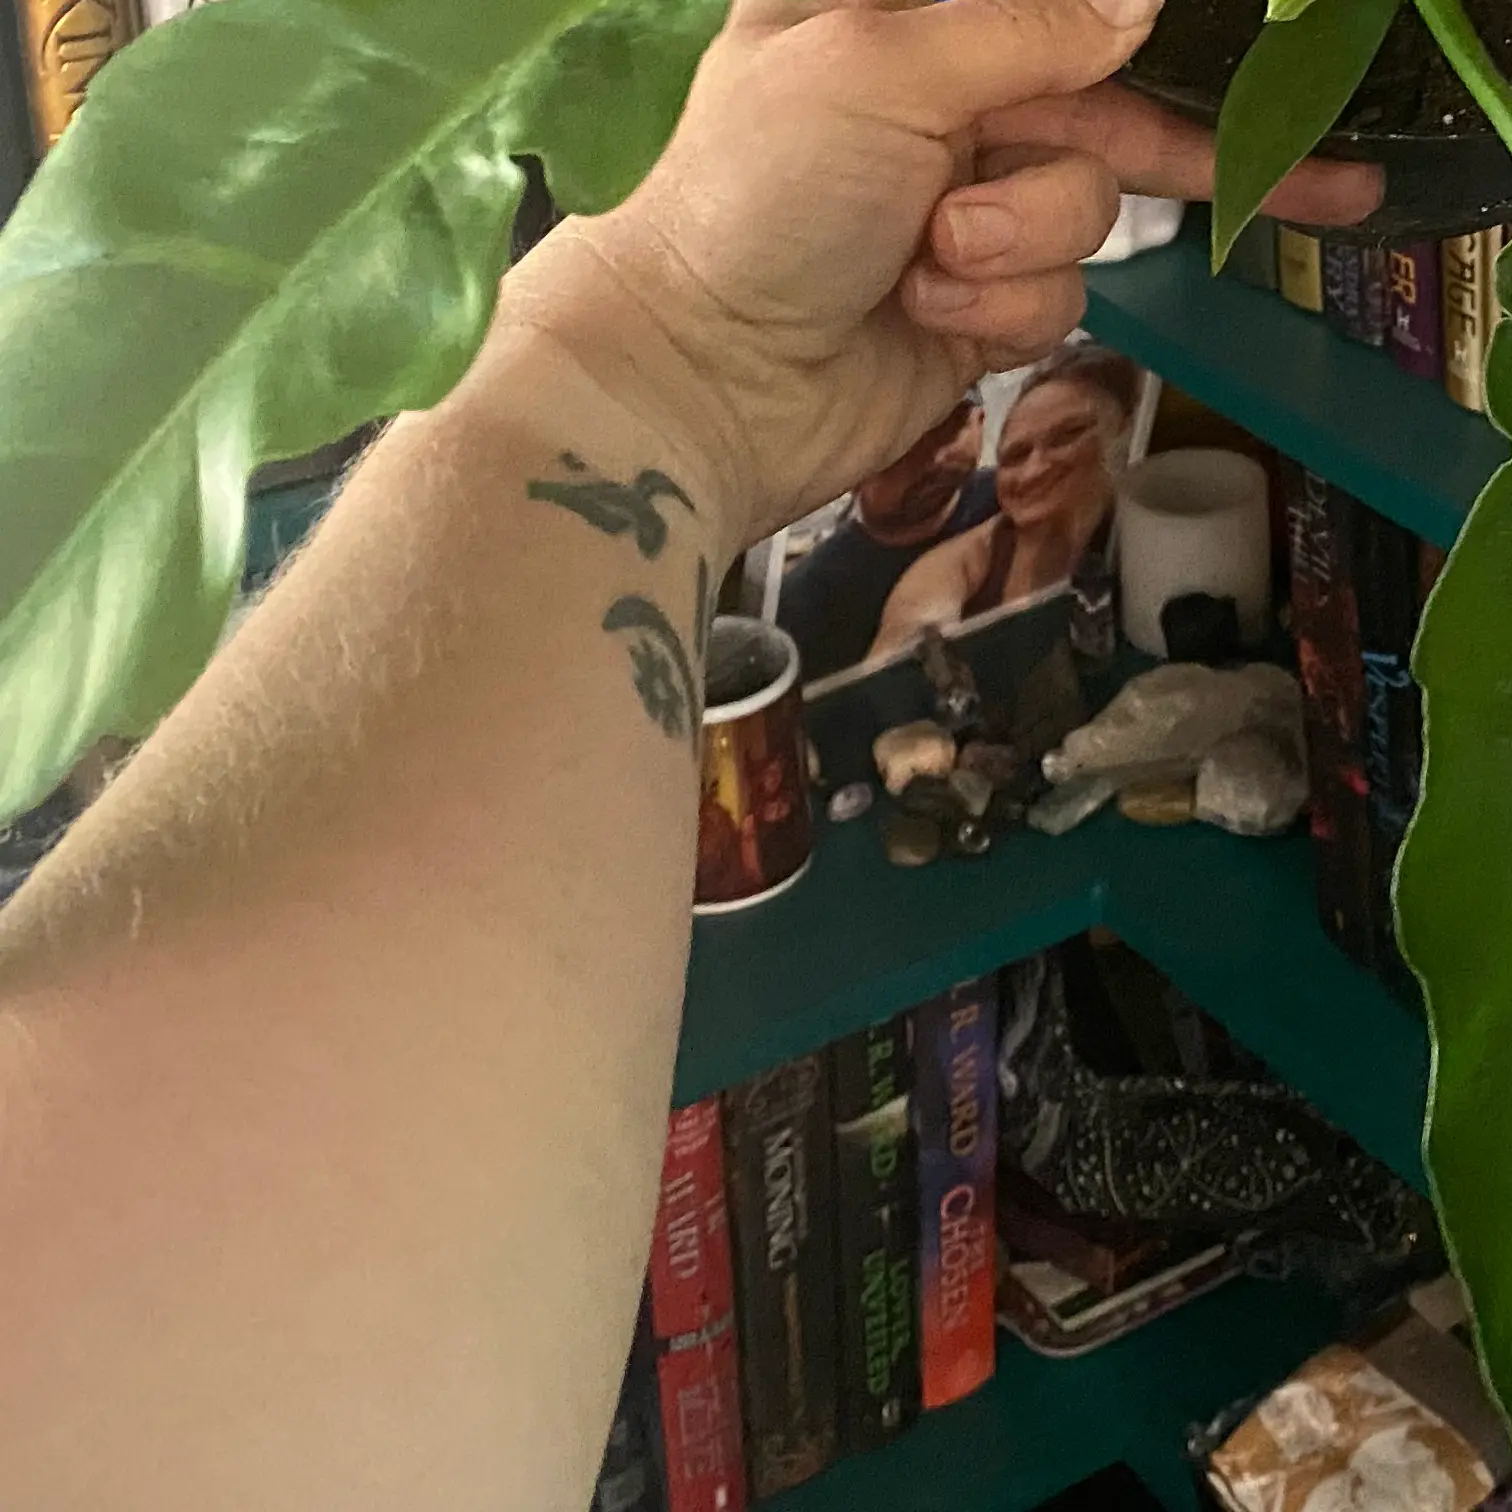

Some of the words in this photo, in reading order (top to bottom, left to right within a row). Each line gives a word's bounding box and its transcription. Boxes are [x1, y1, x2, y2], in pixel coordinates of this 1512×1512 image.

[947, 1046, 981, 1158] WARD
[763, 1126, 800, 1271] MONING
[938, 1182, 978, 1330] CHOSEN
